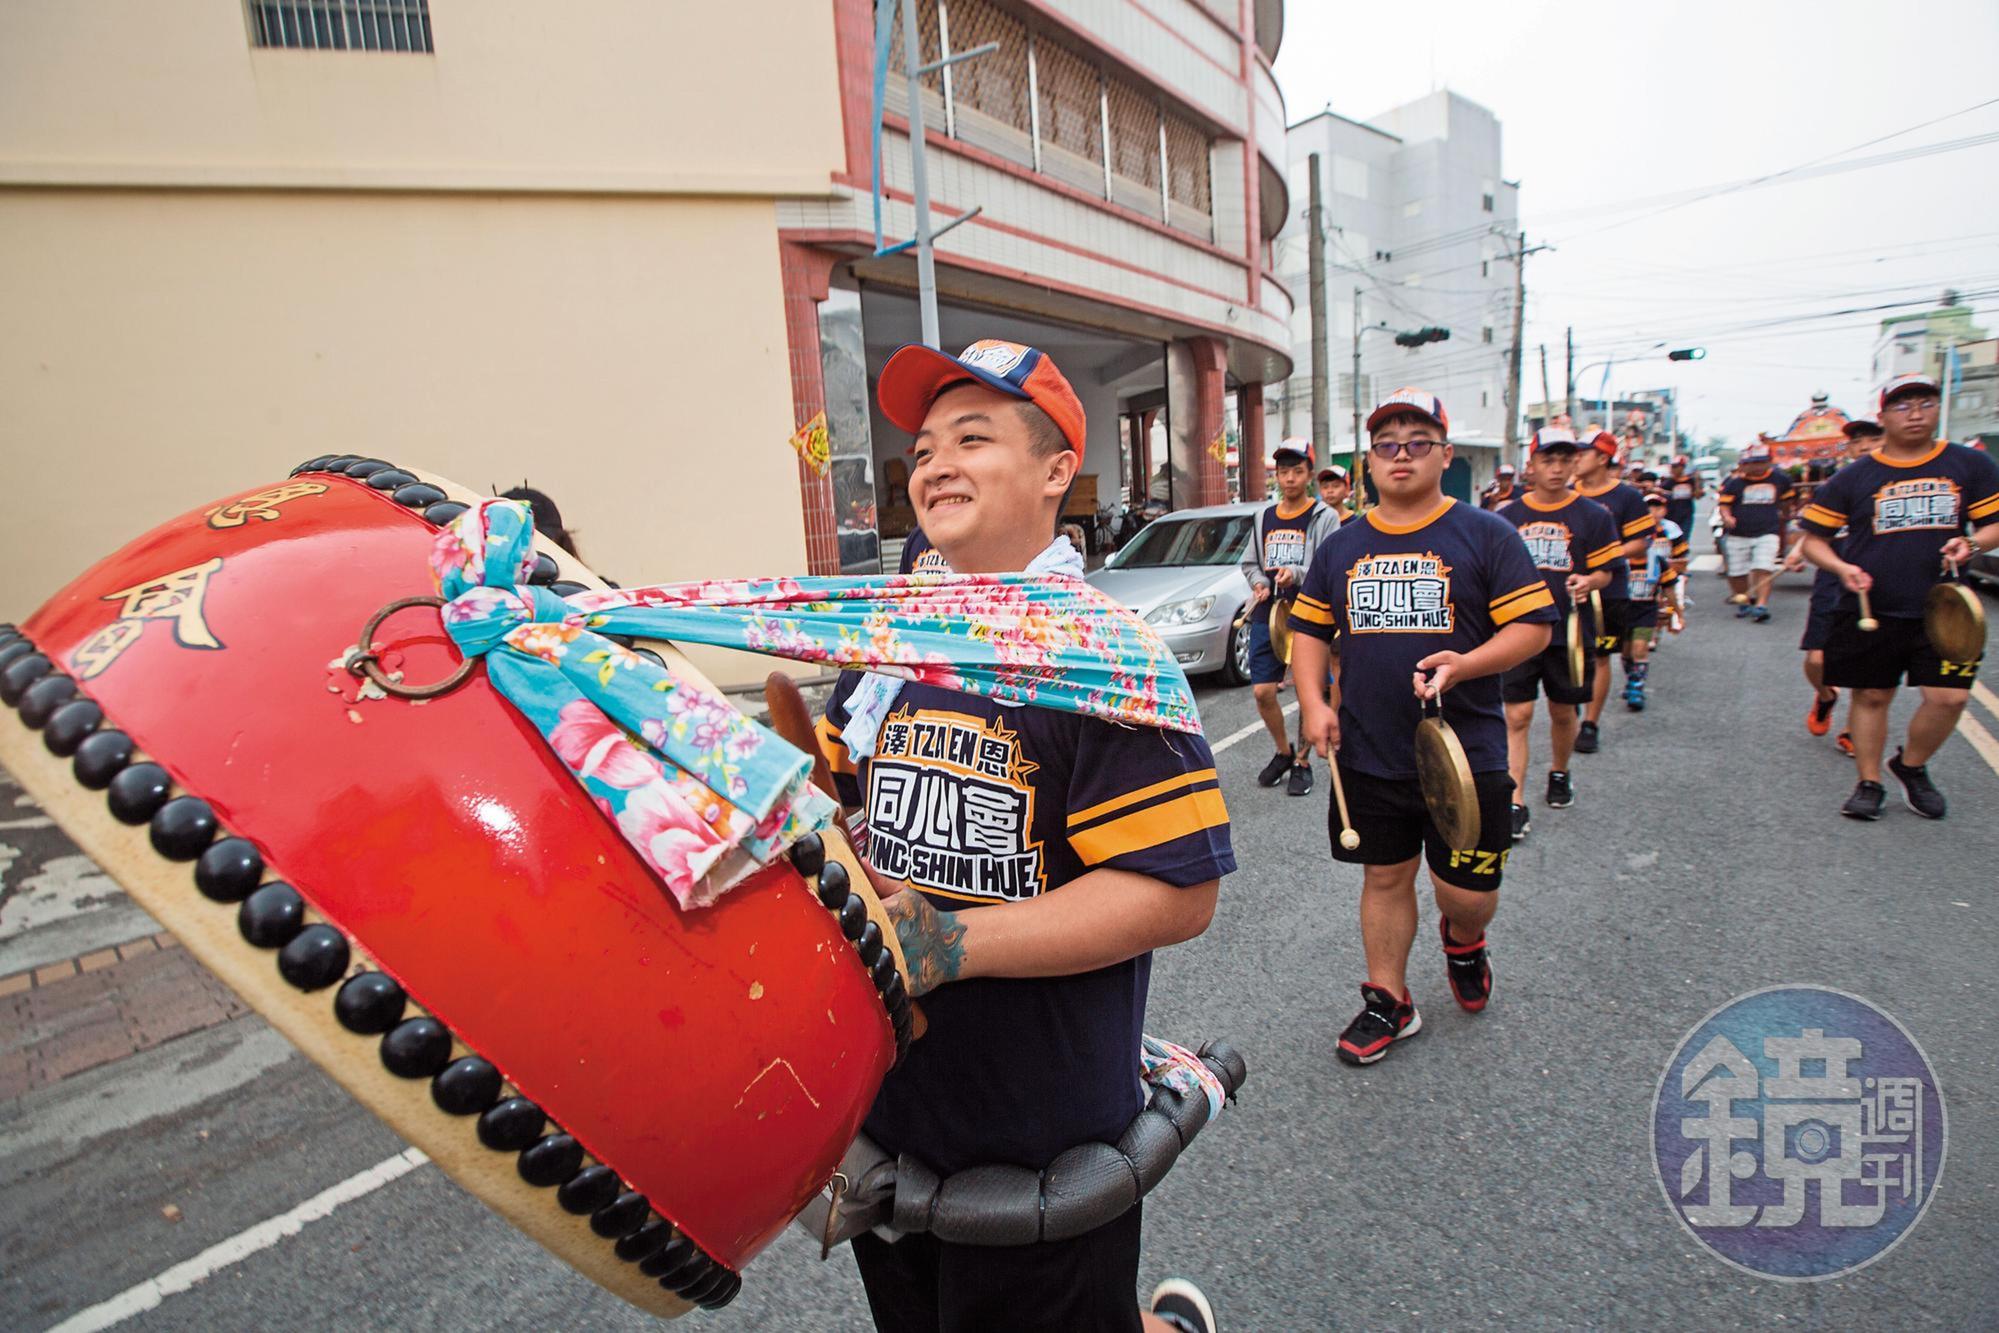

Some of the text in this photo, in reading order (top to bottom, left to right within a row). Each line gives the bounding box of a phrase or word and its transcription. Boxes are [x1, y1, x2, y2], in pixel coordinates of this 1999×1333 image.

[1350, 609, 1449, 629] TUNG SHIN HUE
[1351, 579, 1444, 613] 同心會
[882, 723, 909, 755] 澤
[976, 737, 1011, 779] 恩
[868, 767, 1021, 856] 同心會
[868, 830, 1036, 898] NG SHIN HUE
